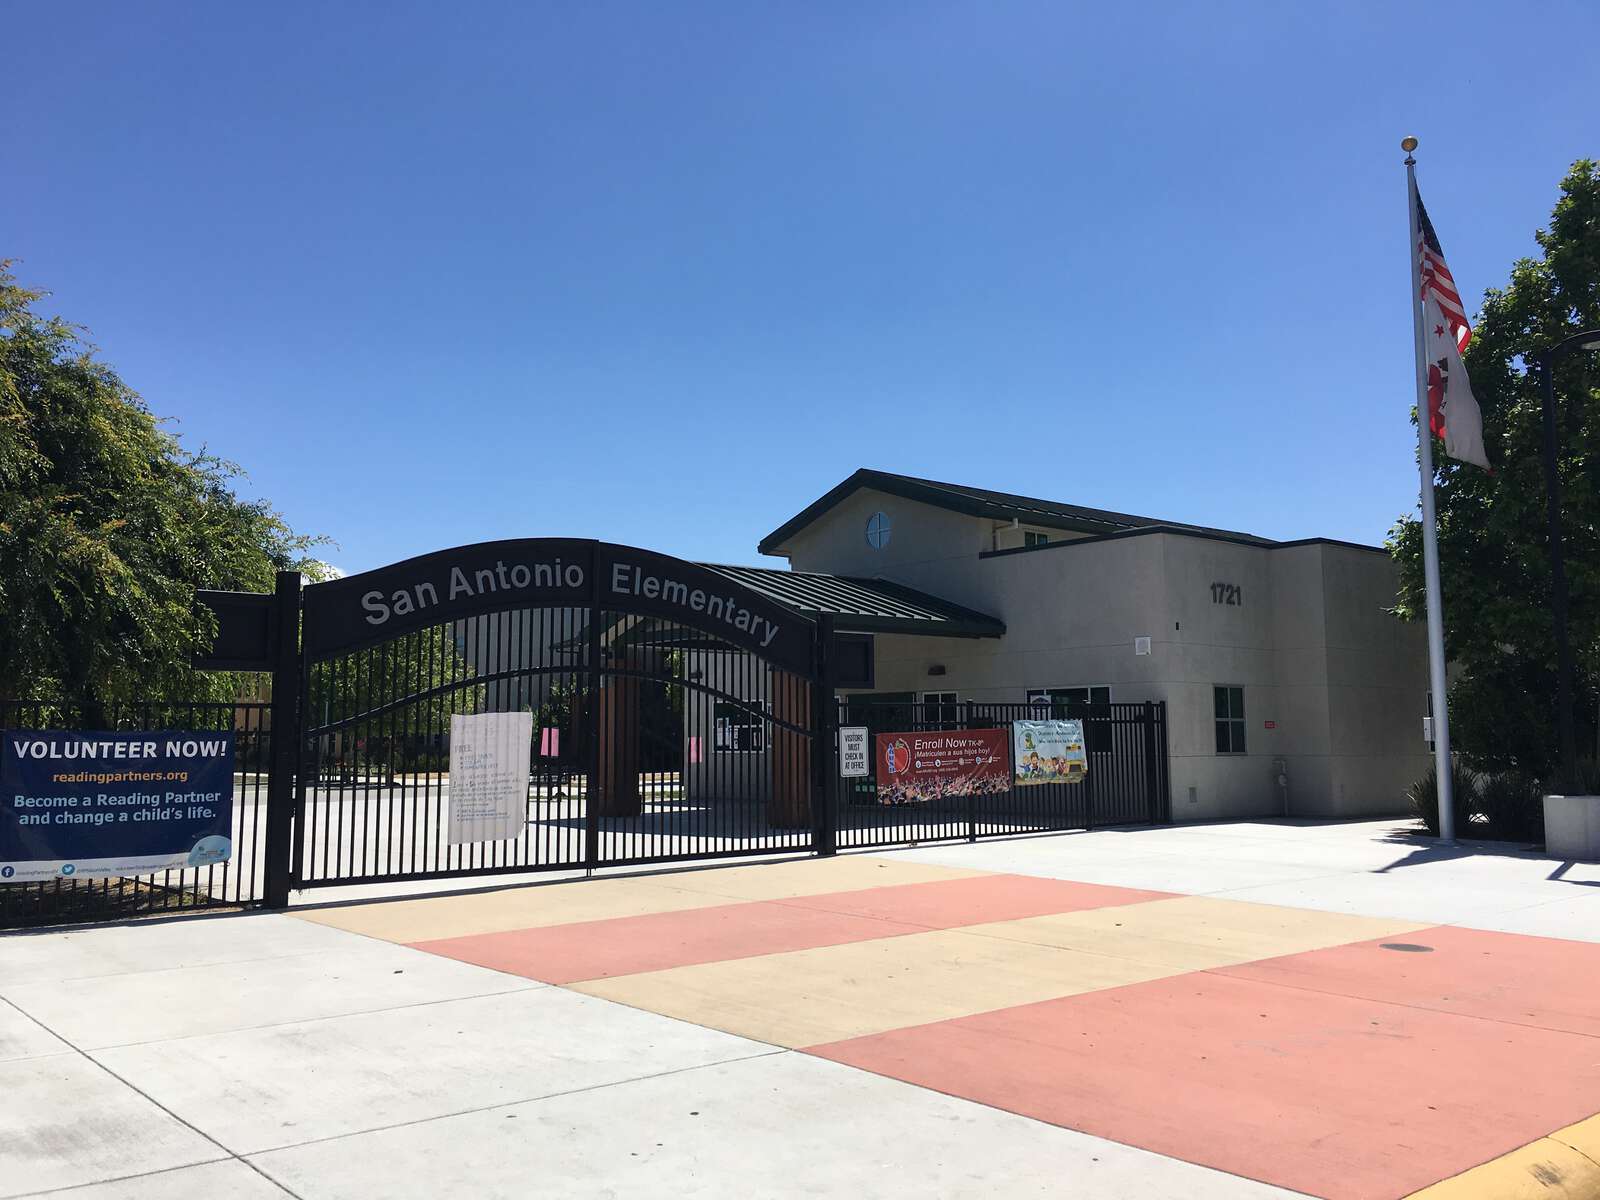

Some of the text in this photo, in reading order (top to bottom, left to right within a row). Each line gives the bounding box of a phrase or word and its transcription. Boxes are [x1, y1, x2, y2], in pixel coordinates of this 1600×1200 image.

[1210, 582, 1242, 607] 1721
[361, 557, 780, 649] San Antonio Elementary
[844, 734, 864, 742] VISITORS
[914, 738, 943, 750] Enroll
[945, 739, 967, 748] Now
[13, 740, 228, 759] VOLUNTEER NOW!
[848, 743, 860, 751] MUST
[964, 748, 977, 757] hijos
[844, 752, 864, 761] CHECK IN
[845, 762, 850, 770] AT
[52, 771, 189, 784] readingpartners.org
[14, 791, 221, 807] Become a Reading Partner
[19, 812, 50, 825] and
[55, 811, 114, 826] change
[119, 812, 128, 822] a
[188, 806, 217, 819] life.
